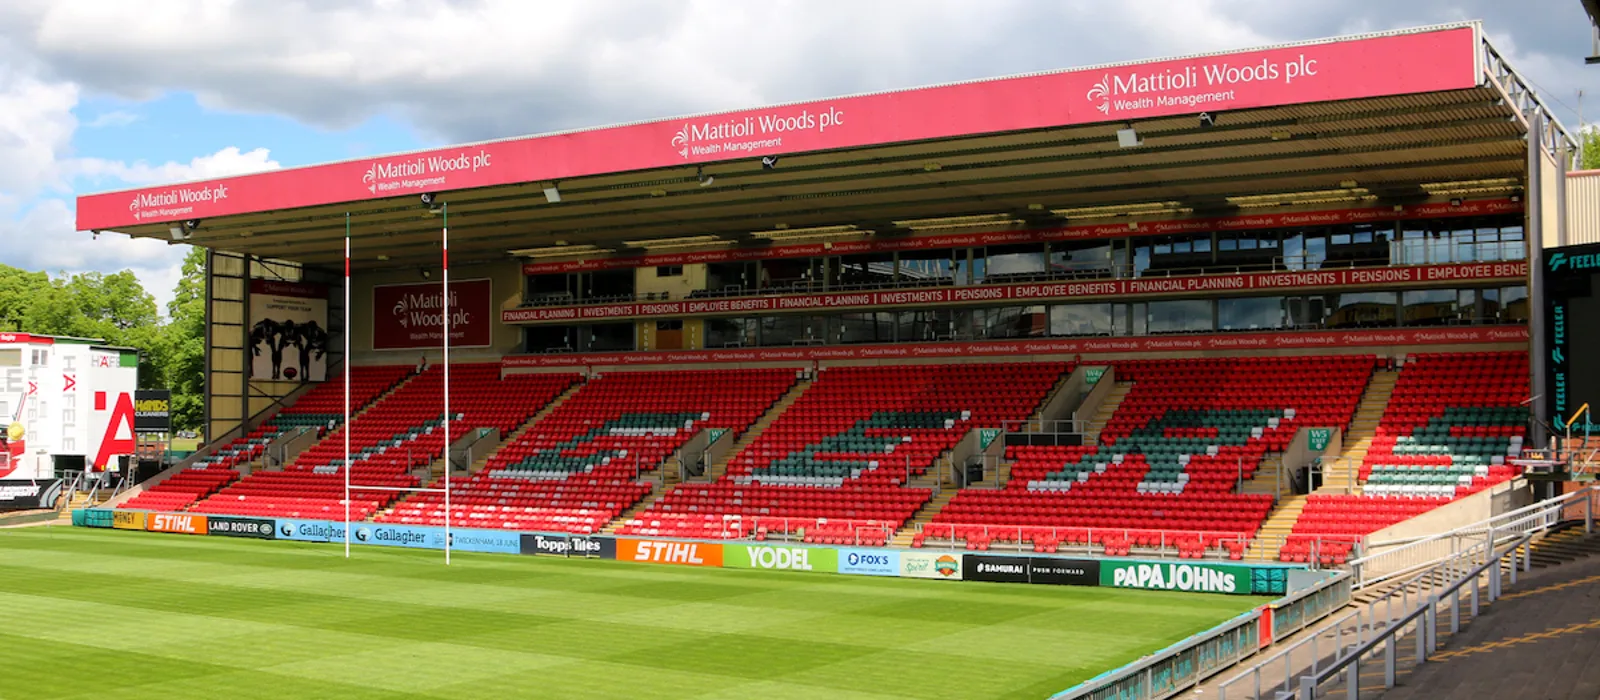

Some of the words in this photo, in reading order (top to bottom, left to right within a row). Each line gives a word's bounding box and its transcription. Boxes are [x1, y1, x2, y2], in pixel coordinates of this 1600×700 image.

[1114, 66, 1197, 96] Mattioli
[1203, 58, 1278, 86] Woods
[1286, 54, 1318, 84] plc
[1114, 97, 1154, 112] Wealth
[1157, 89, 1234, 108] Management
[691, 117, 754, 142] Mattioli
[758, 111, 815, 134] Woods
[819, 107, 844, 132] plc
[691, 143, 722, 156] Wealth
[724, 137, 782, 152] Management
[378, 158, 424, 179] Mattioli
[428, 153, 470, 173] Woods
[472, 150, 491, 172] plc
[378, 181, 400, 191] Wealth
[402, 176, 446, 188] Management
[141, 189, 178, 207] Mattioli
[180, 186, 212, 203] Woods
[214, 183, 228, 203] plc
[410, 290, 457, 309] Mattili
[504, 310, 538, 321] FINANCIAL
[540, 308, 574, 319] PLANNING
[584, 305, 632, 317] INVESTMENTS
[642, 303, 679, 314] PENSIONS
[690, 300, 729, 312] EMPLOYEE
[730, 298, 768, 310] BENEFITS
[780, 296, 823, 307] FINANCIAL
[826, 294, 869, 306] PLANNING
[881, 291, 942, 304] INVESTMENTS
[955, 287, 1002, 300] PENSIONS
[1016, 284, 1066, 297] EMPLOYEE
[1069, 282, 1116, 296] BENEFITS
[1130, 278, 1185, 293] FINANCIAL
[1188, 275, 1244, 290] PLANNING
[1259, 272, 1336, 287] INVESTMENTS
[1352, 268, 1410, 283] PENSIONS
[1428, 264, 1490, 280] EMPLOYEE
[452, 308, 470, 329] plc
[62, 355, 76, 451] HÄFELE
[1310, 429, 1328, 438] W5
[154, 514, 196, 532] STIHL
[208, 521, 230, 531] LAND
[231, 522, 258, 533] ROVER
[300, 524, 346, 541] Gallagher
[375, 528, 426, 544] Gallagher
[535, 535, 572, 553] Topps
[572, 538, 600, 551] Tiles
[634, 541, 704, 564] STIHL
[747, 546, 812, 570] YODEL
[861, 555, 888, 565] FOX'S
[985, 564, 1023, 574] SAMURAI
[1114, 565, 1165, 588] PAPA
[1165, 563, 1236, 592] JOHNS
